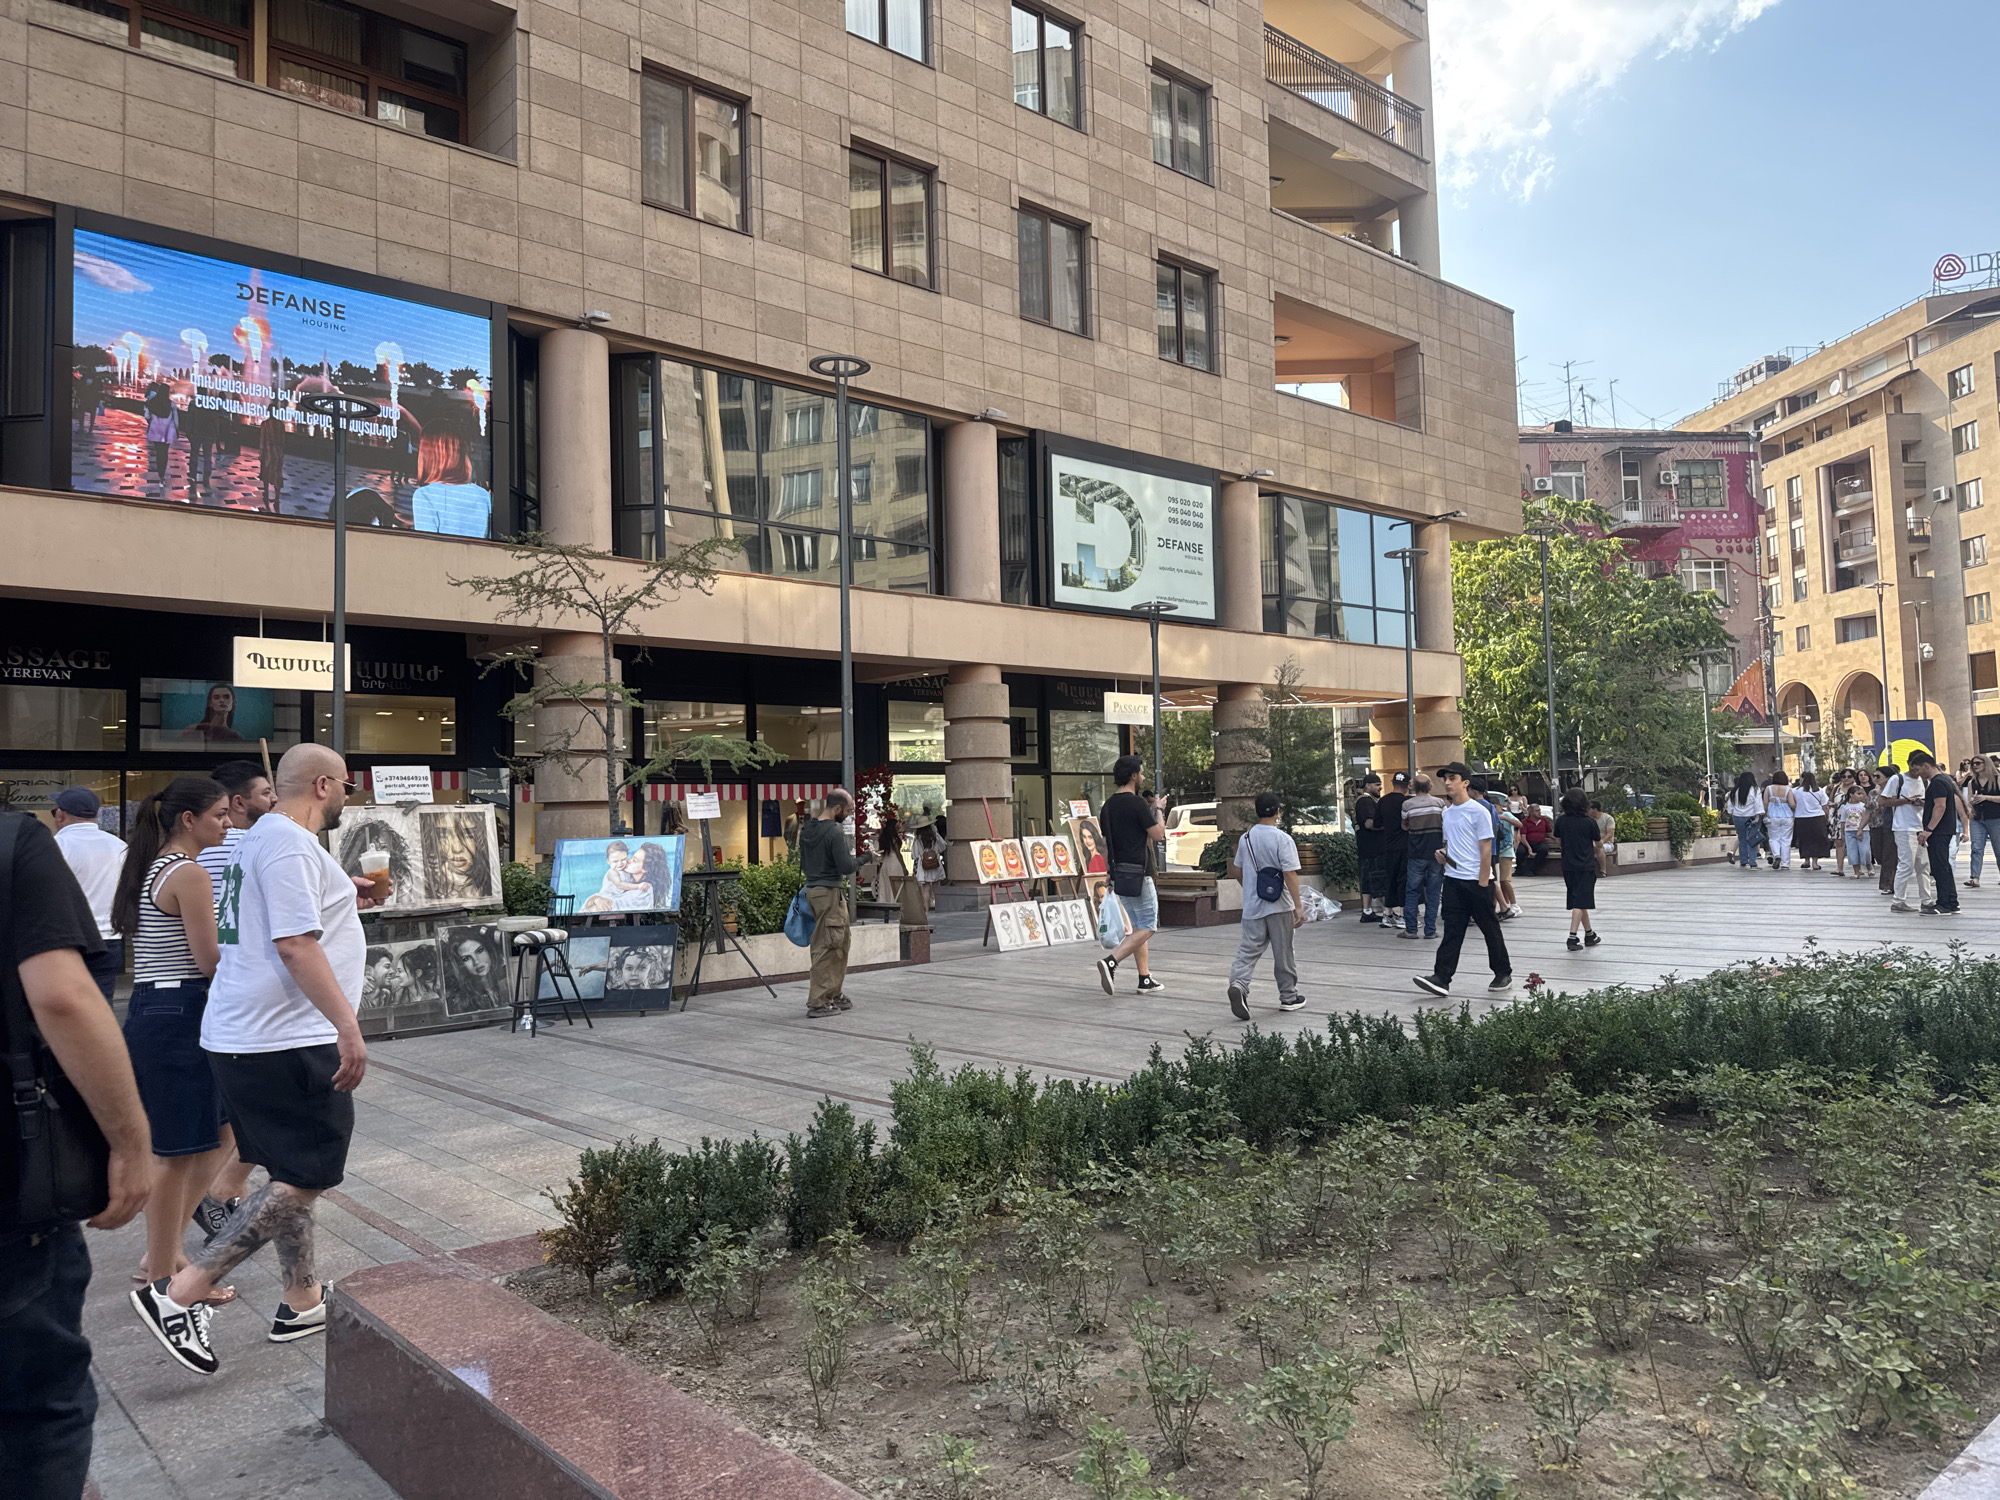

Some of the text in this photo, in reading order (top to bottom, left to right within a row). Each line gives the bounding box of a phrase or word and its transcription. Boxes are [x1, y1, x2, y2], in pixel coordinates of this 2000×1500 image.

[1970, 251, 2000, 273] ID
[236, 282, 346, 321] DEFANSE
[302, 318, 347, 333] HOUSING
[1167, 496, 1204, 509] 095 020 020
[1167, 506, 1204, 519] 095 040 040
[1167, 516, 1204, 529] 095 060 060
[1157, 536, 1204, 555] DEFANSE
[0, 645, 111, 670] SSAGE
[2, 667, 73, 680] YEREVAN
[912, 688, 943, 697] YEREVAN
